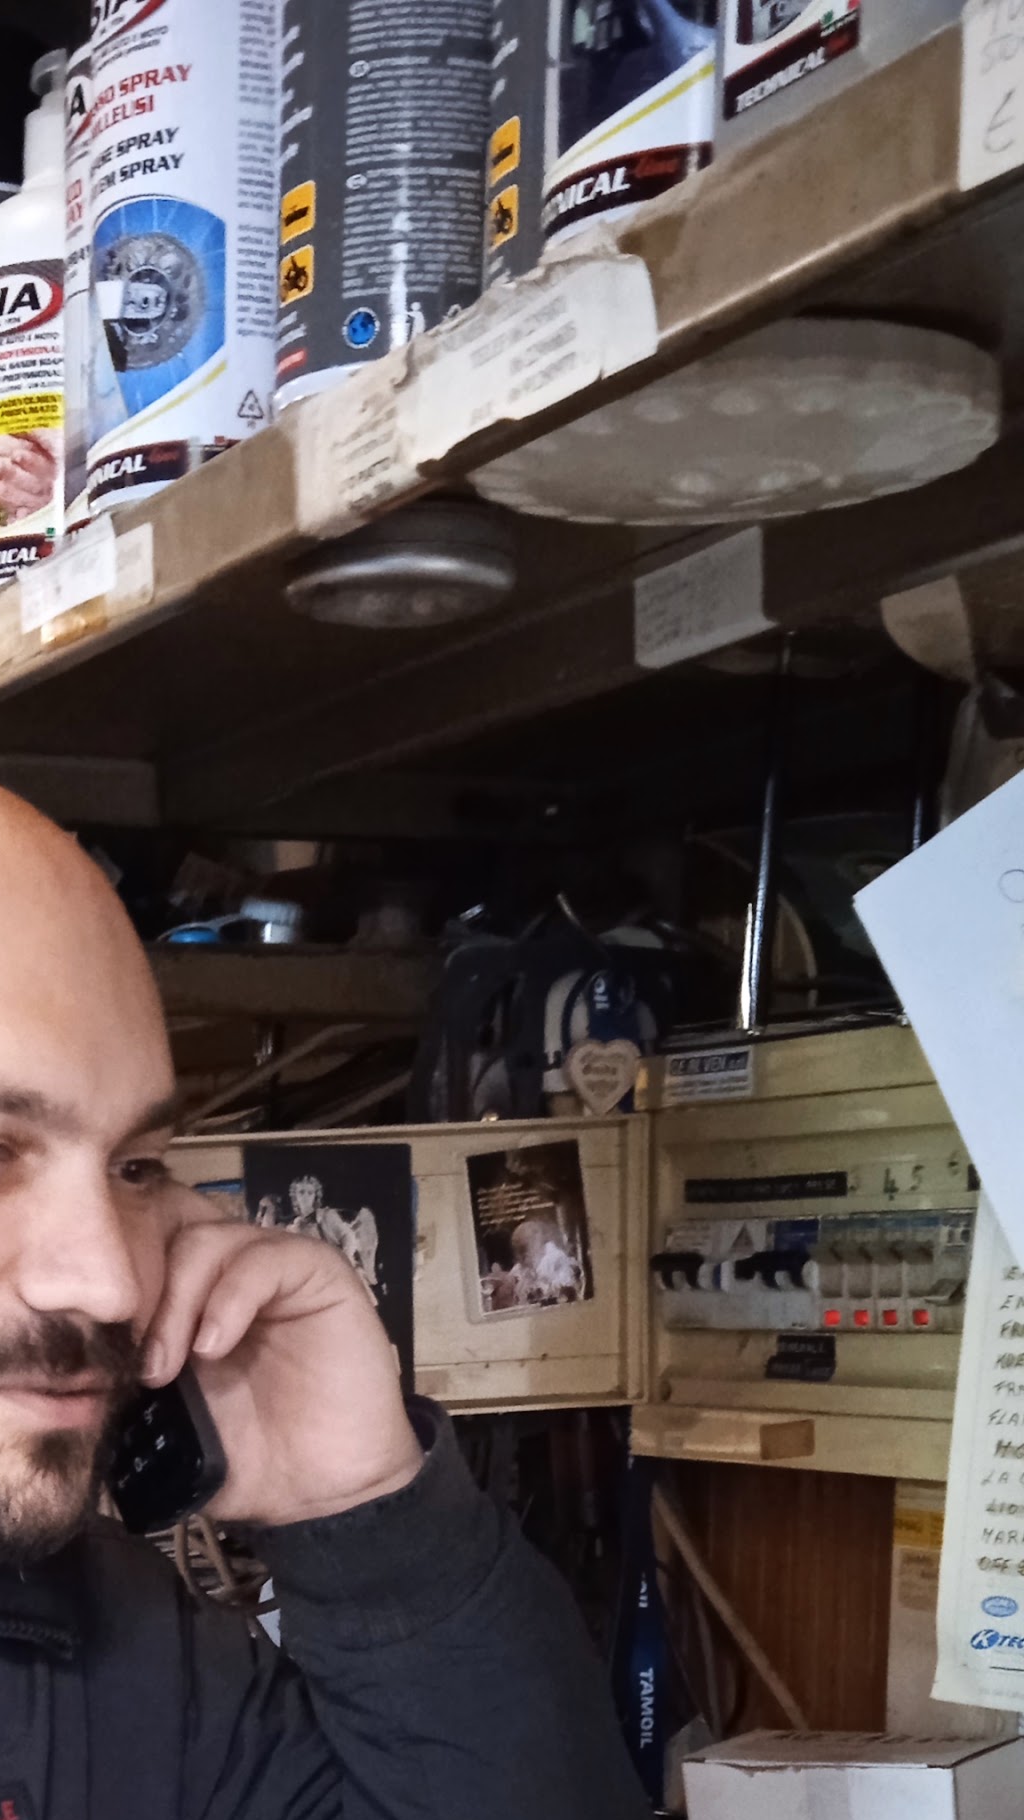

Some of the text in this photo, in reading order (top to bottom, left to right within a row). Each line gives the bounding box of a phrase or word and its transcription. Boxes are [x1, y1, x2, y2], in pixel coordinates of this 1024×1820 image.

[119, 64, 192, 97] SPRAY
[117, 127, 180, 157] SPRAY
[120, 153, 186, 183] SPRAY
[639, 1667, 655, 1749] TAMOIL
